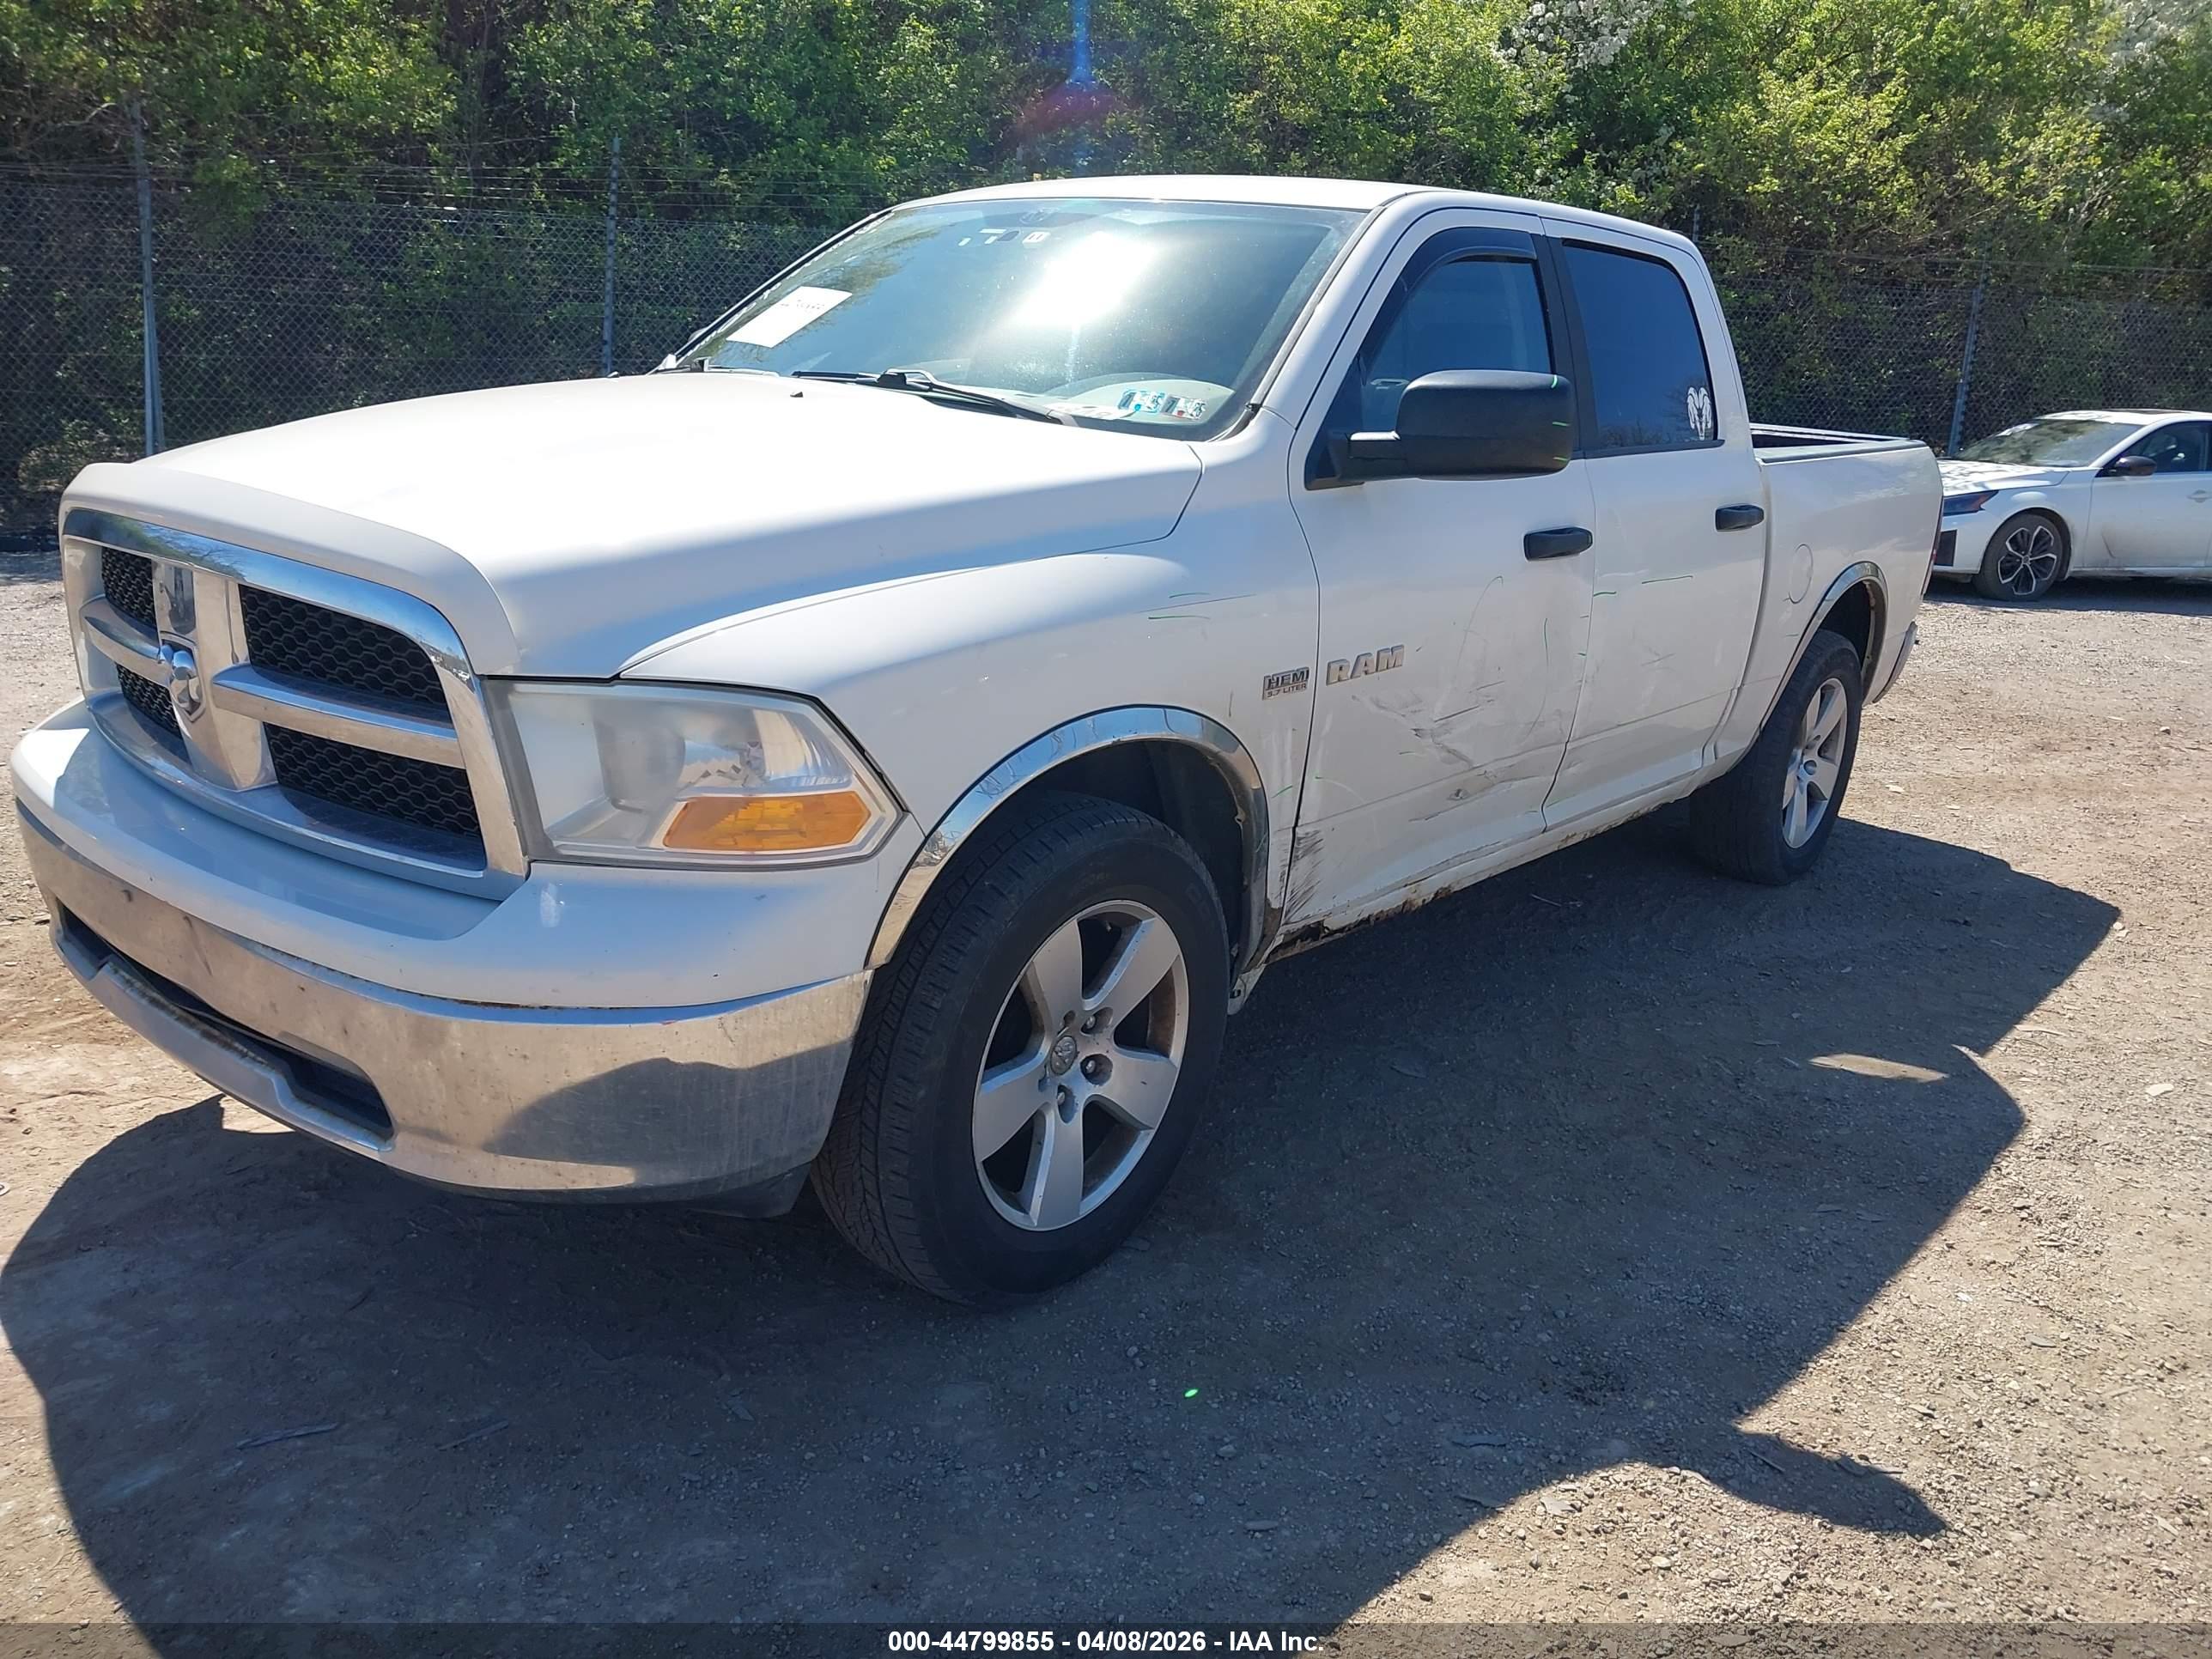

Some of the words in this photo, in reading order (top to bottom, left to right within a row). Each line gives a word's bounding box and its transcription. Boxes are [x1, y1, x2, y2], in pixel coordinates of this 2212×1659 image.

[1327, 645, 1404, 685] RAM
[1263, 666, 1310, 691] HEMI
[1282, 683, 1307, 694] LITER
